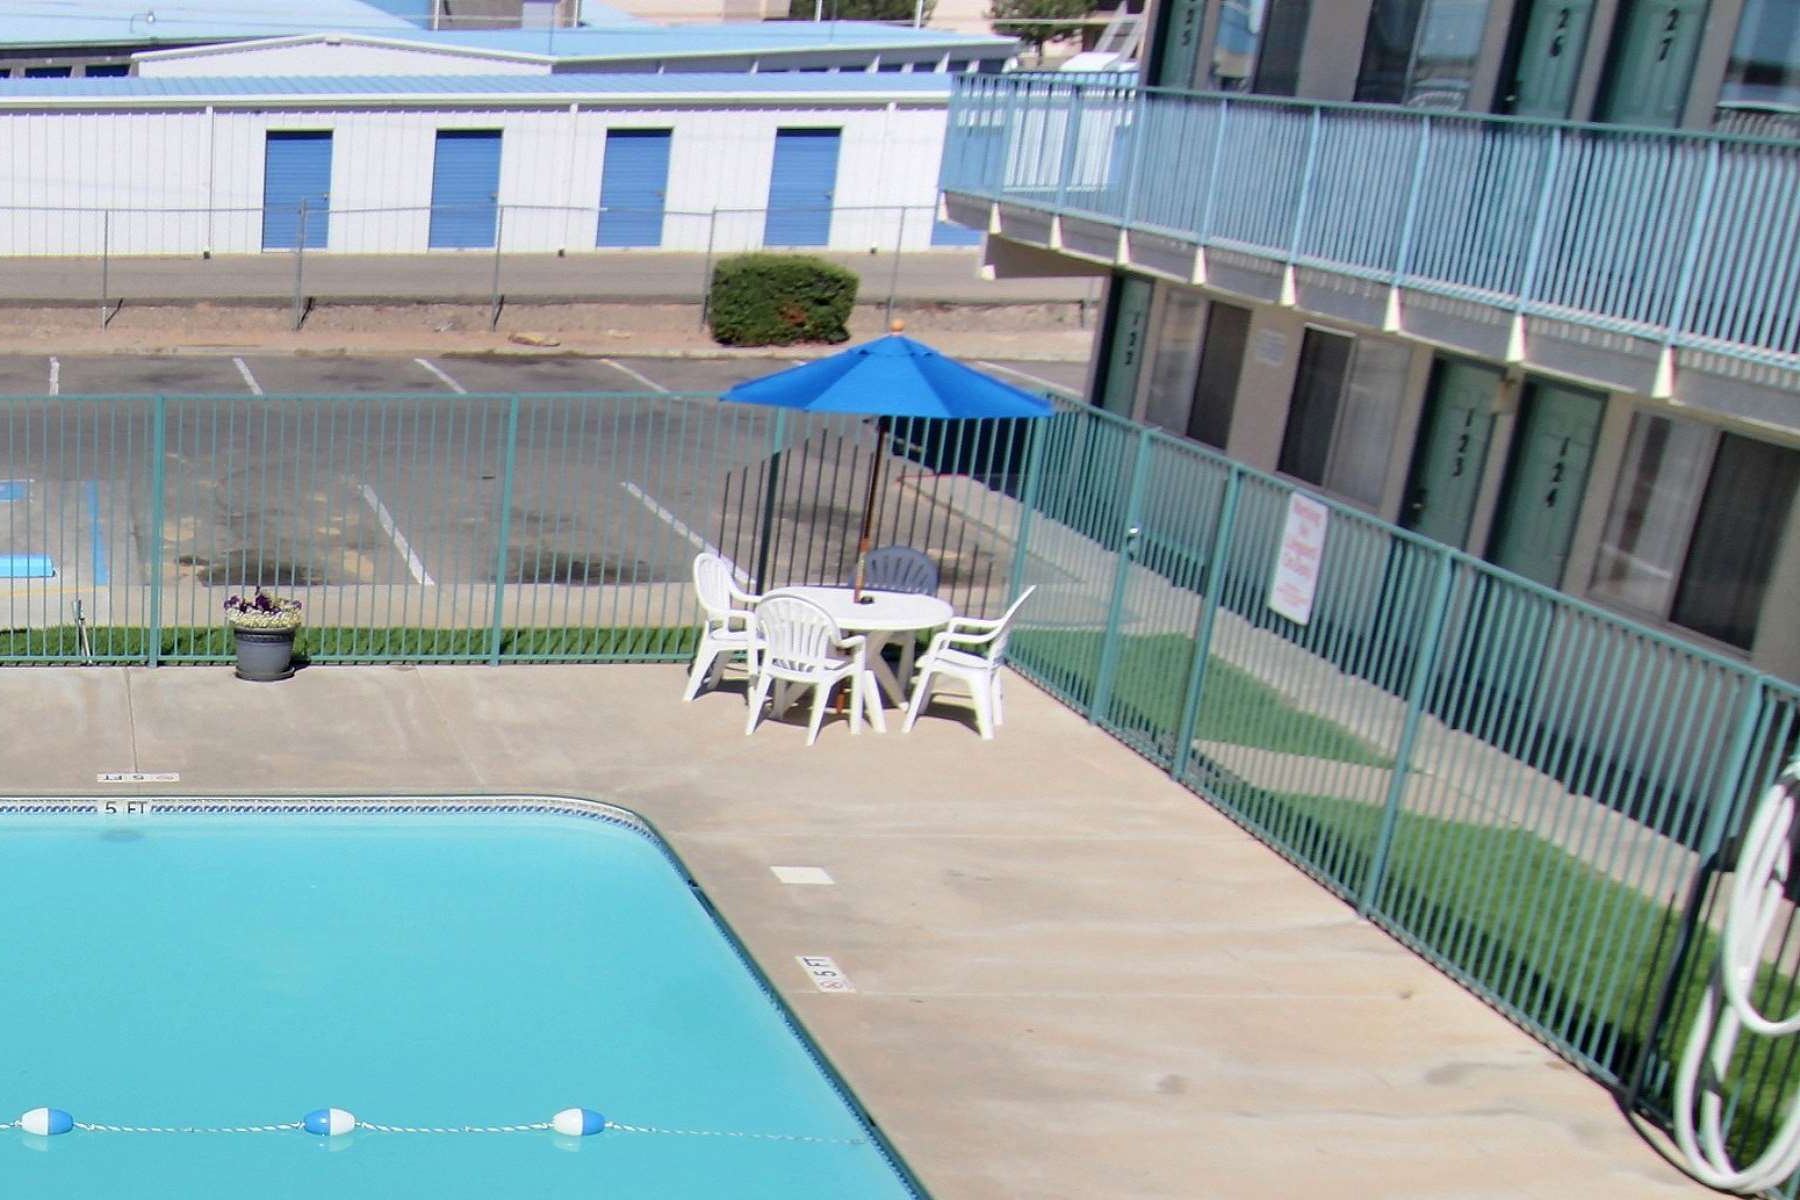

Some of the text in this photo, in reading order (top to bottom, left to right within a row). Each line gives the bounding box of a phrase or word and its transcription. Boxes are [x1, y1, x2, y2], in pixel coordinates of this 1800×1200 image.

[1544, 435, 1571, 507] 124
[105, 801, 148, 815] 5 FT
[802, 956, 830, 967] FT
